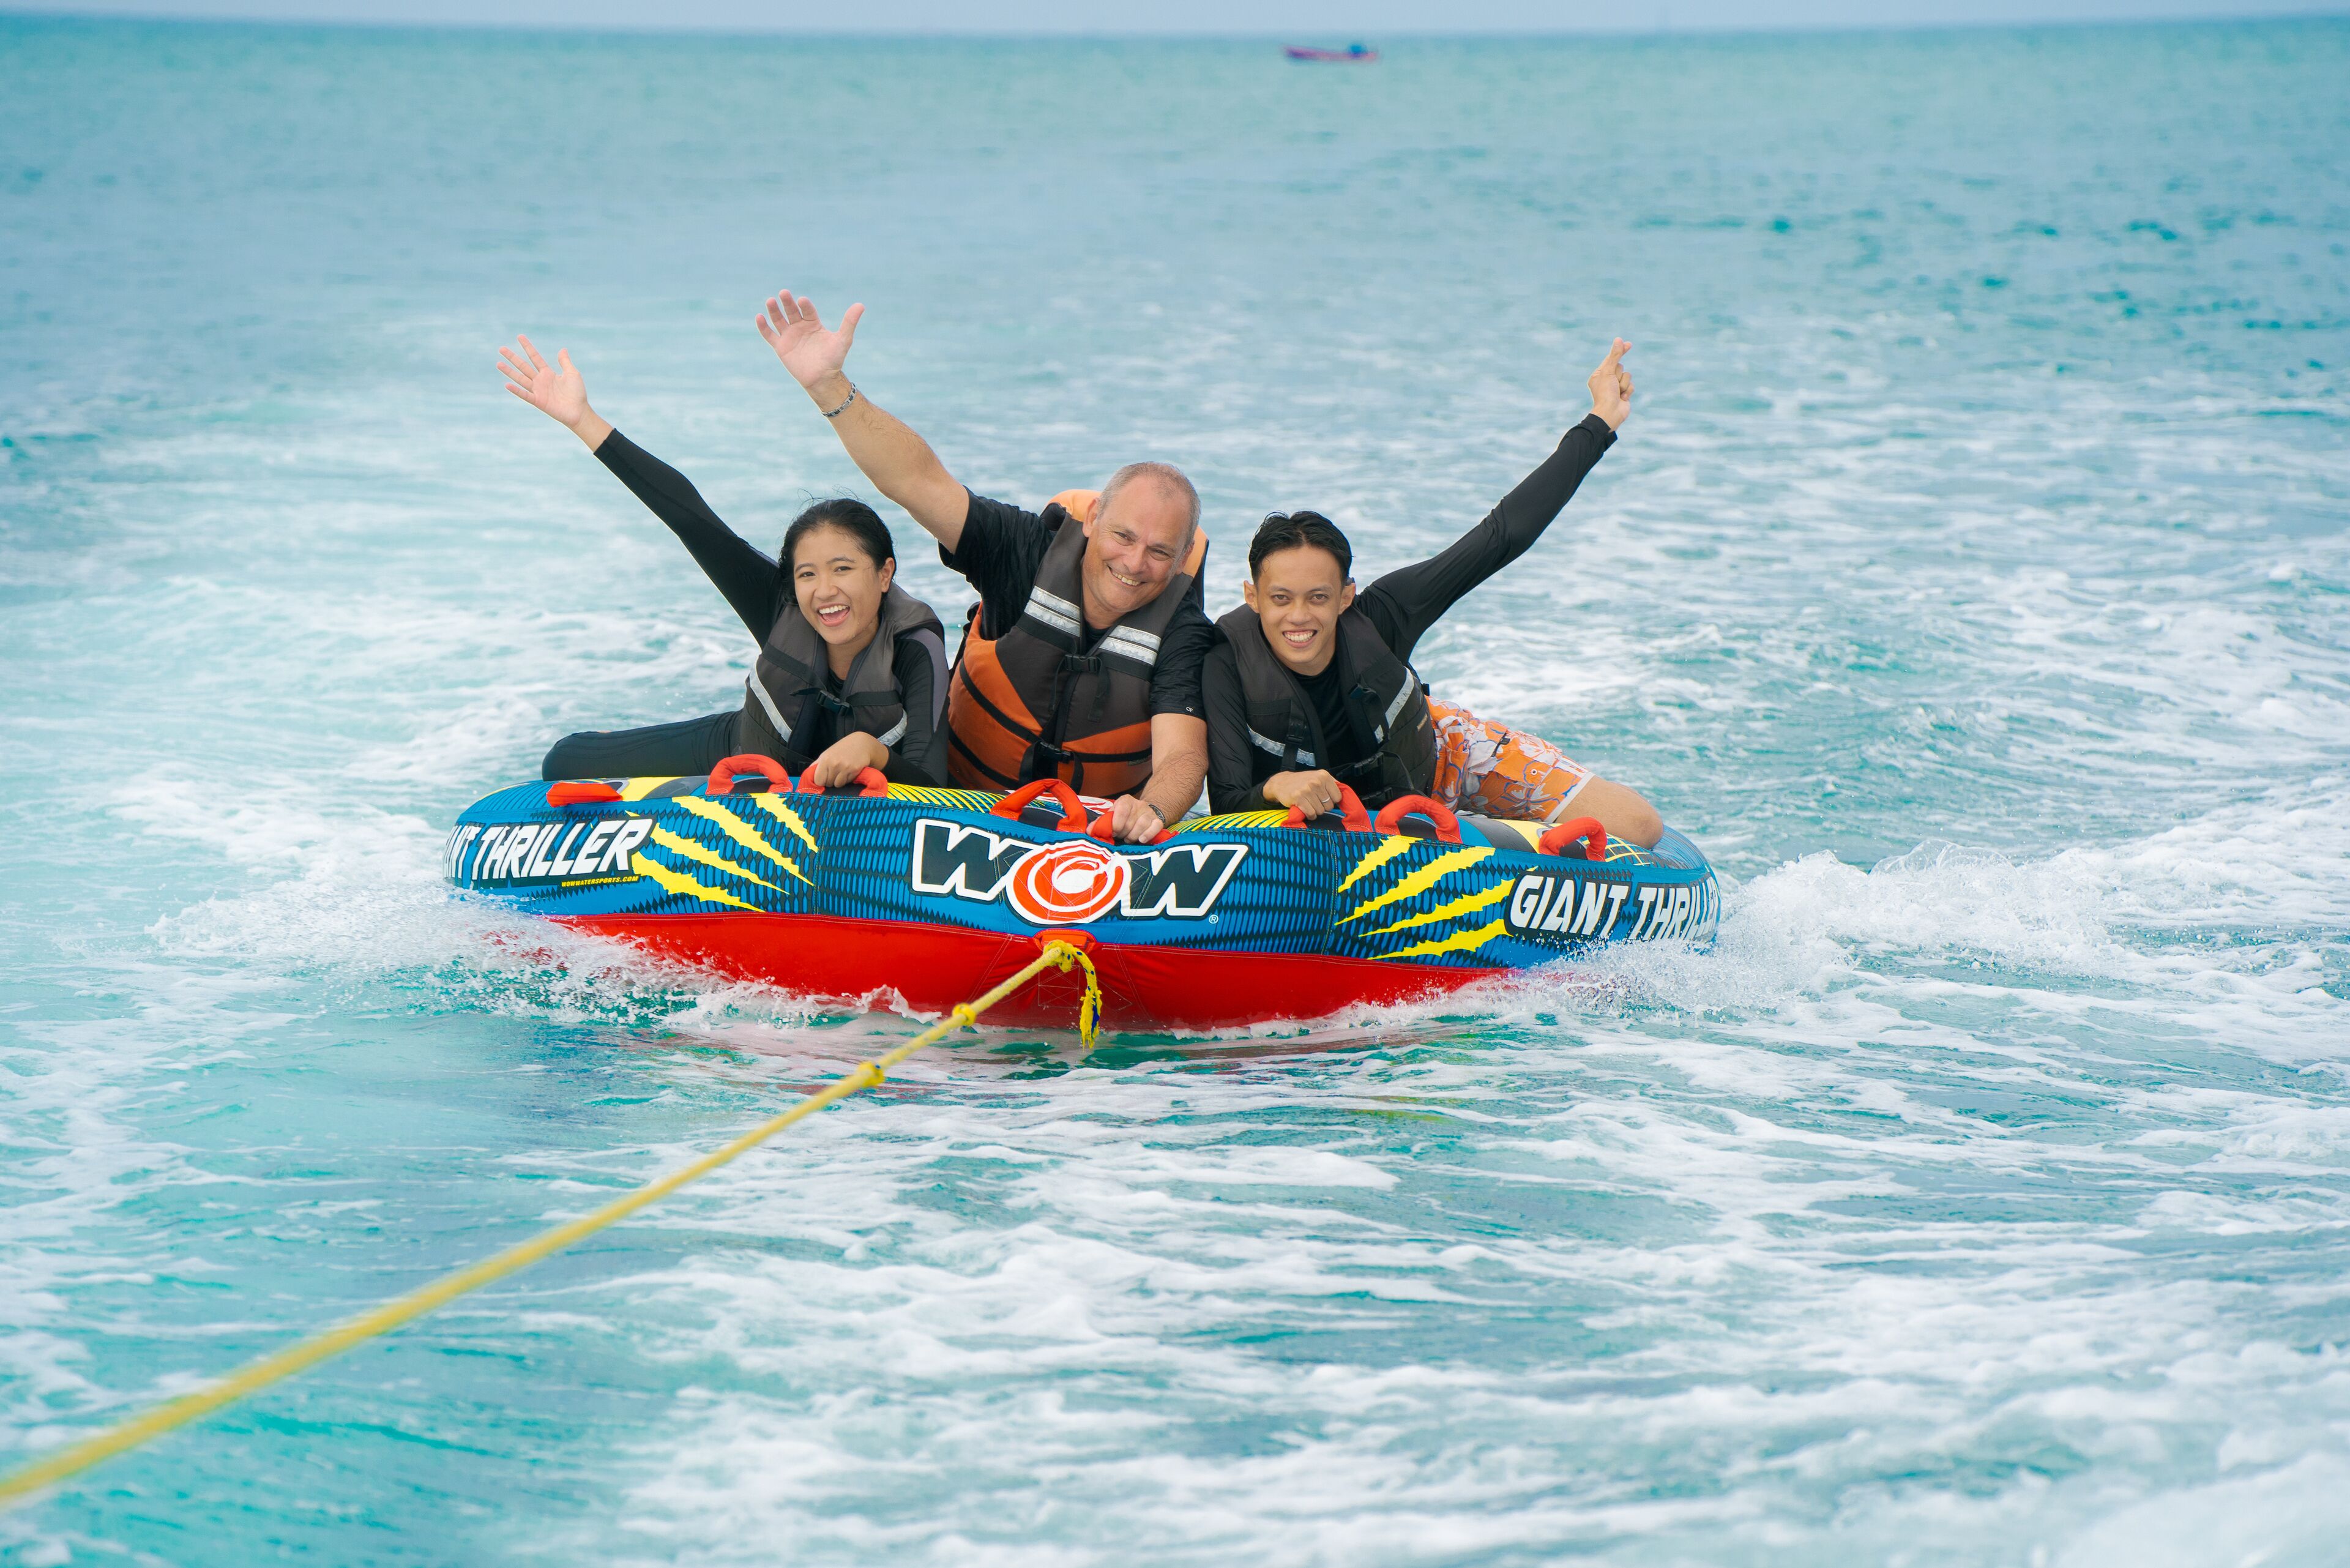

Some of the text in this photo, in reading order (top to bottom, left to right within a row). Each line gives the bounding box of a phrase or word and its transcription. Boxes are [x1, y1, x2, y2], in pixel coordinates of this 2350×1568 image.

[472, 818, 653, 880] THRILLER
[912, 818, 1248, 924] WOW
[561, 875, 640, 887] WOWWATERSPORTS.COM
[1510, 875, 1629, 938] GIANT
